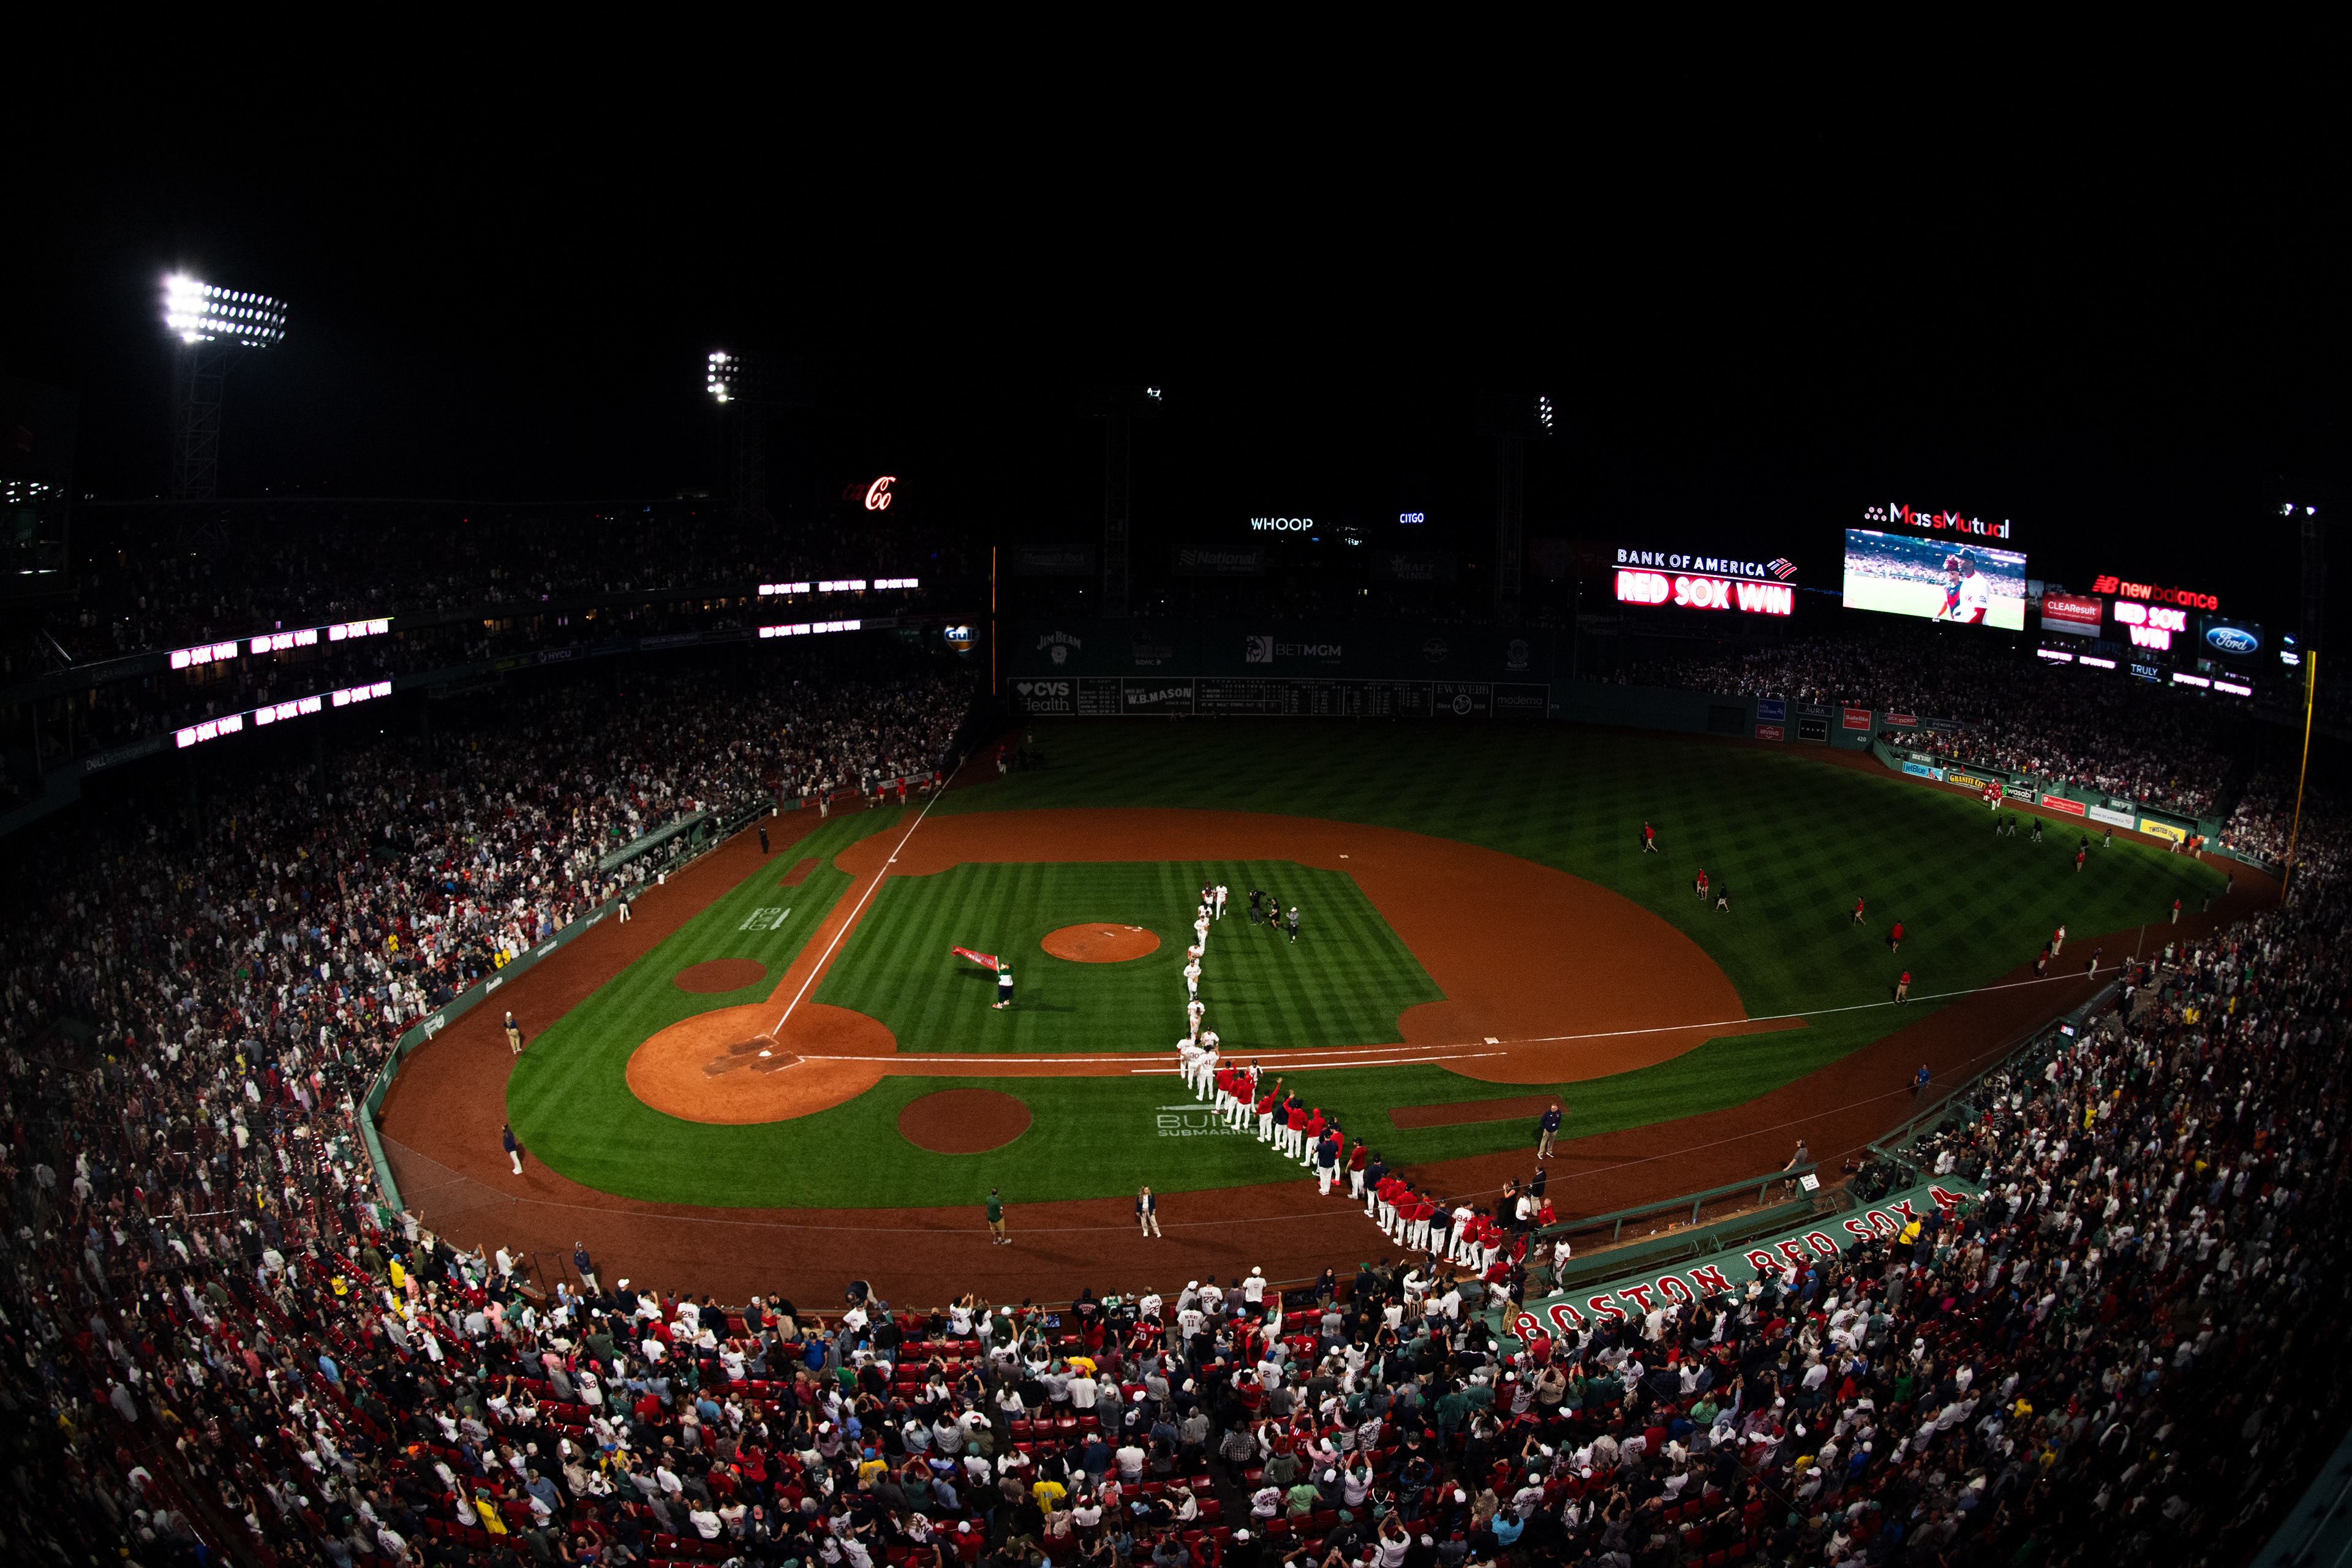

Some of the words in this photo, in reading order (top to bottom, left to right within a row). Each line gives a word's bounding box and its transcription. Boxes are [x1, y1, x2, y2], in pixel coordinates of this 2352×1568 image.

[1251, 518, 1313, 530] WHOOP
[1400, 513, 1424, 524] CITGO
[1890, 502, 2009, 538] MassMutual
[1197, 551, 1256, 565] National
[1618, 549, 1664, 566] BANK
[1670, 554, 1691, 568] OF
[1694, 557, 1765, 576] AMERICA
[1398, 571, 1433, 580] KINGS
[1617, 571, 1669, 603] RED
[1674, 576, 1731, 609] SOX
[1736, 582, 1792, 615] WIN
[2048, 601, 2095, 615] CLEAResult
[2114, 601, 2147, 624] RED
[2149, 606, 2186, 631] SOX
[946, 628, 978, 640] Gulf
[2130, 625, 2171, 650] WIN
[1037, 635, 1055, 650] JIM
[1056, 631, 1081, 650] BEAM
[2216, 631, 2248, 650] Ford
[549, 650, 571, 660] HYCU
[1276, 644, 1341, 656] BETMGM
[2131, 664, 2158, 676] TRULY
[1034, 682, 1069, 696] CVS
[1458, 685, 1489, 694] WEBB
[1018, 698, 1069, 711] Health
[1497, 696, 1542, 705] moderna
[1905, 764, 1925, 774] jetBlue
[1950, 774, 1974, 785] GRANITE
[834, 791, 854, 800] SEATGEEK
[2008, 788, 2032, 799] wasabi
[2149, 826, 2168, 835] TWISTED
[1156, 1115, 1259, 1128] BUIL
[1158, 1128, 1267, 1137] SUBMARINE
[1456, 1215, 1469, 1223] 84
[1512, 1264, 1733, 1343] BOSTON
[1743, 1231, 1841, 1276] RED
[1843, 1198, 1918, 1242] SOX
[680, 1310, 694, 1319] 28
[584, 1379, 597, 1389] 83
[1359, 1397, 1366, 1408] 16
[1263, 1496, 1277, 1507] 43
[1523, 1498, 1537, 1507] 34
